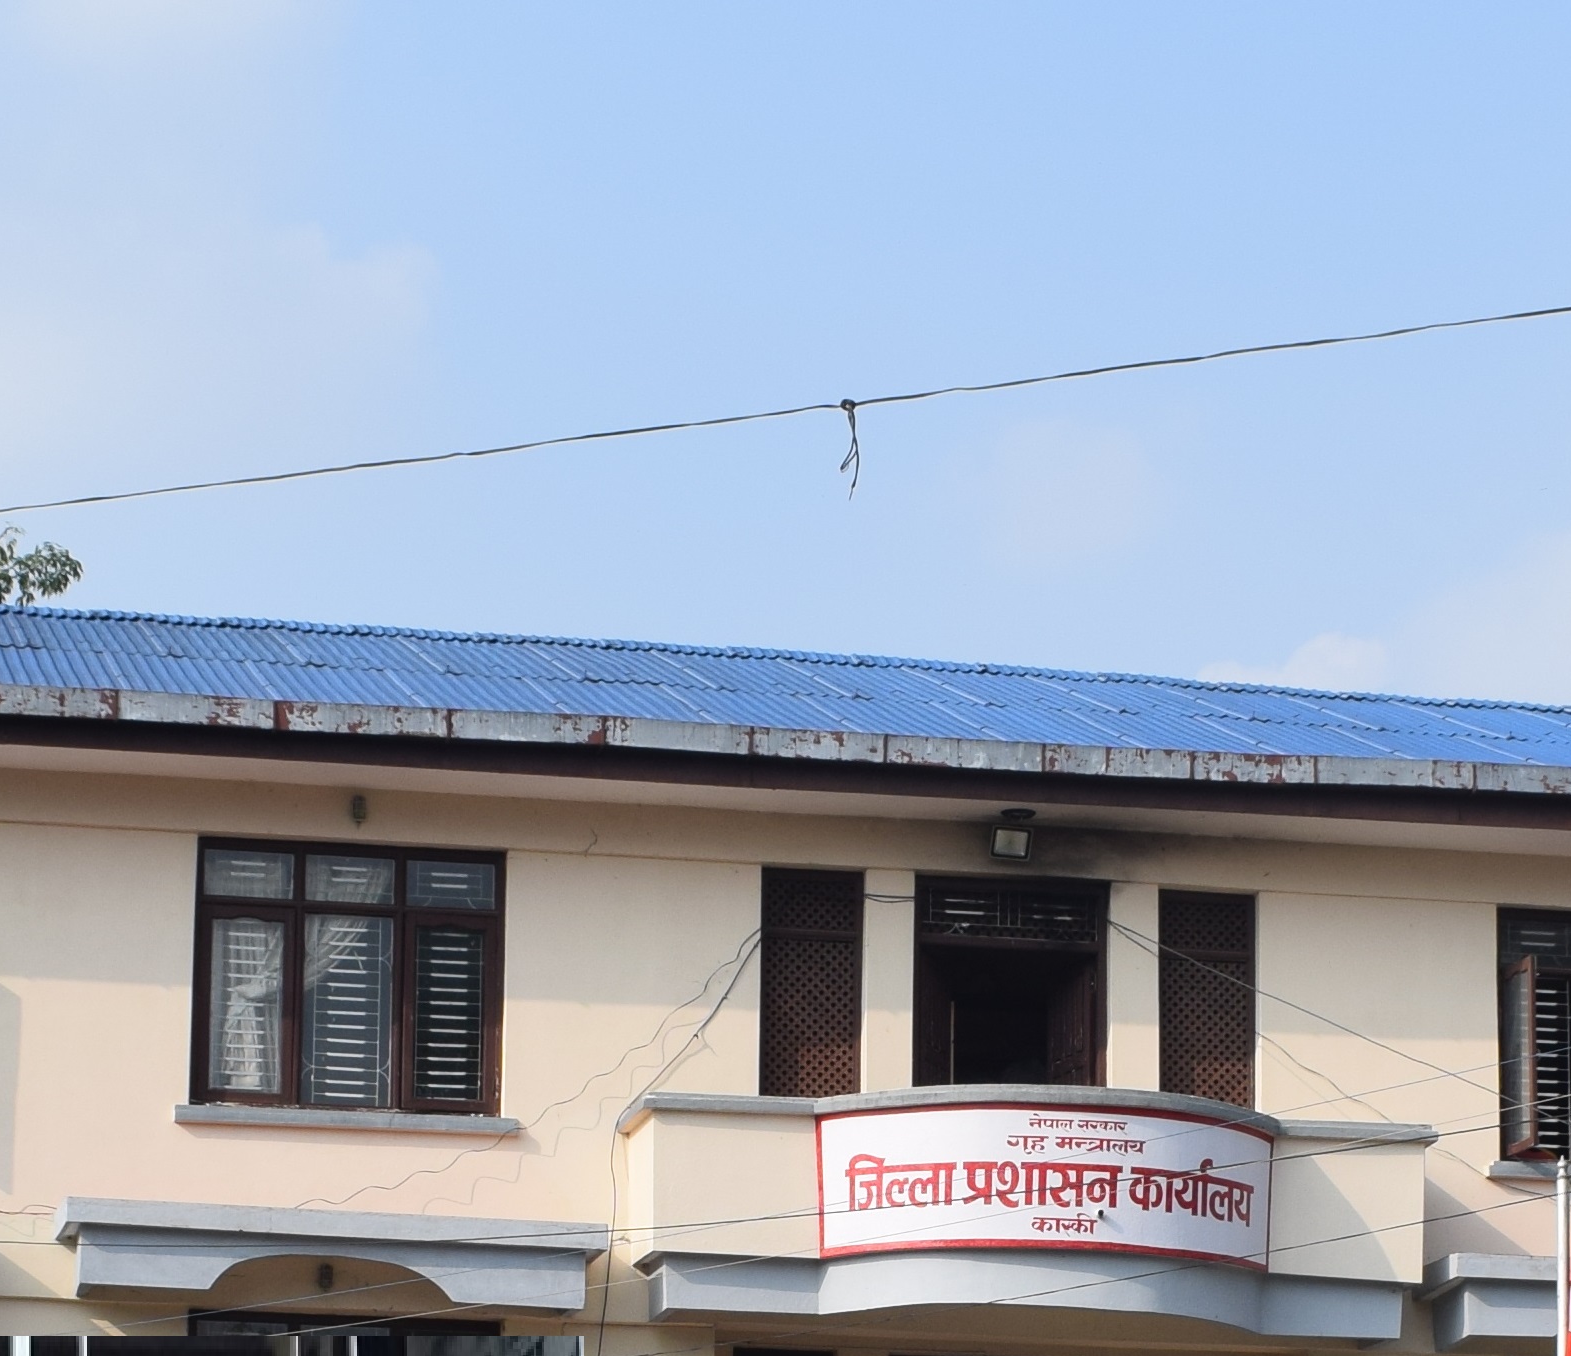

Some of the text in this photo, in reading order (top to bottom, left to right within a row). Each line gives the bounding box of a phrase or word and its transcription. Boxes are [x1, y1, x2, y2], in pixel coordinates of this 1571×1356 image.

[1028, 1113, 1072, 1132] नेपाल
[1007, 1135, 1147, 1156] गृह मन्त्रालय
[845, 1153, 1255, 1227] जिल्ला प्रशासन कार्यालय
[1031, 1211, 1098, 1236] कास्की
